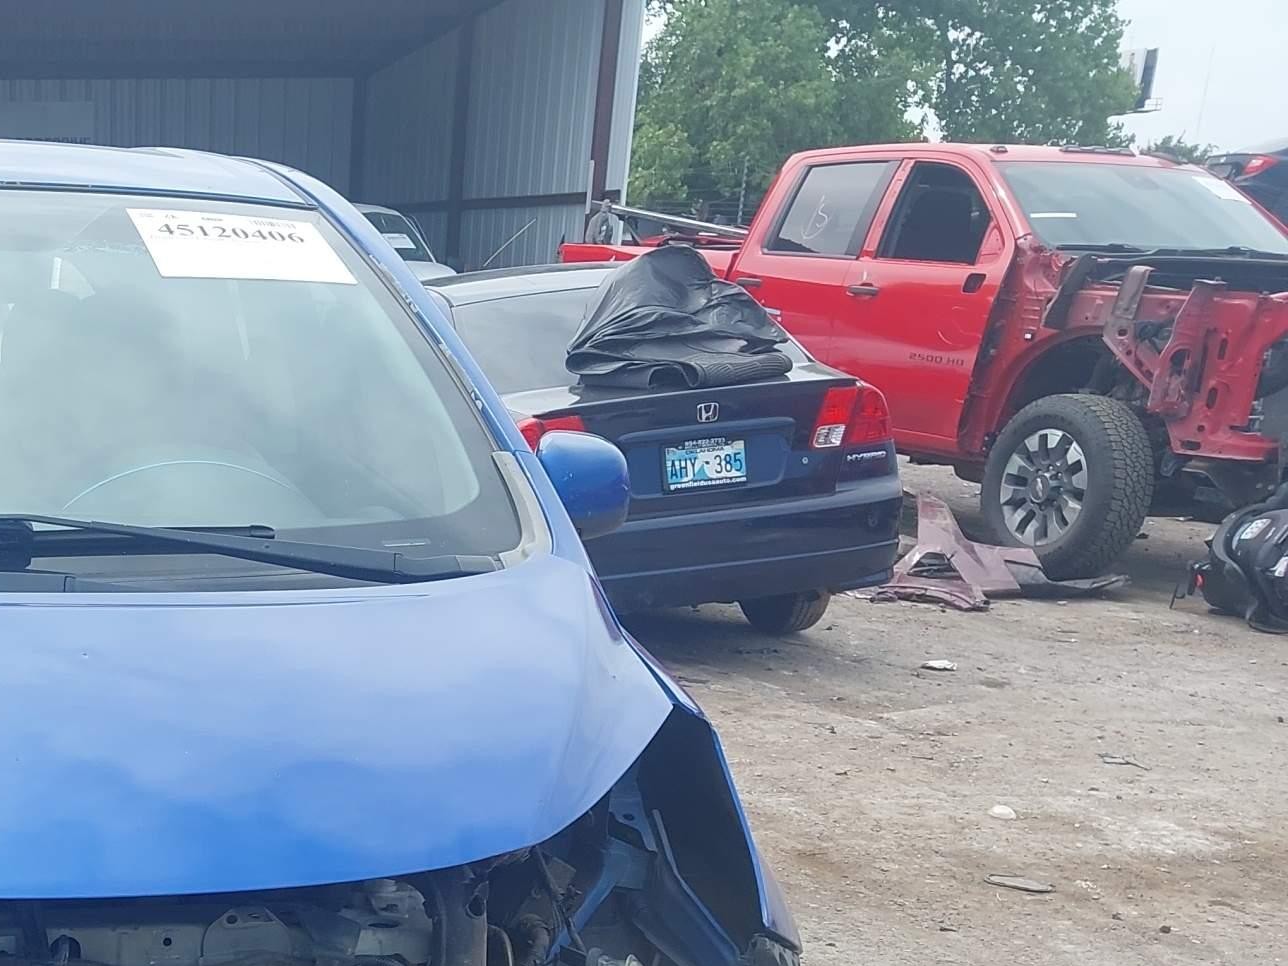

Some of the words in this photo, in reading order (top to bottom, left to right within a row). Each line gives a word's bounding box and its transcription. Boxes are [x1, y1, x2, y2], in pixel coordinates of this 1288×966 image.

[158, 222, 305, 244] 45120406
[909, 352, 943, 364] 2500
[846, 451, 887, 461] HYBRID
[670, 456, 697, 480] AHY
[714, 452, 744, 474] 385
